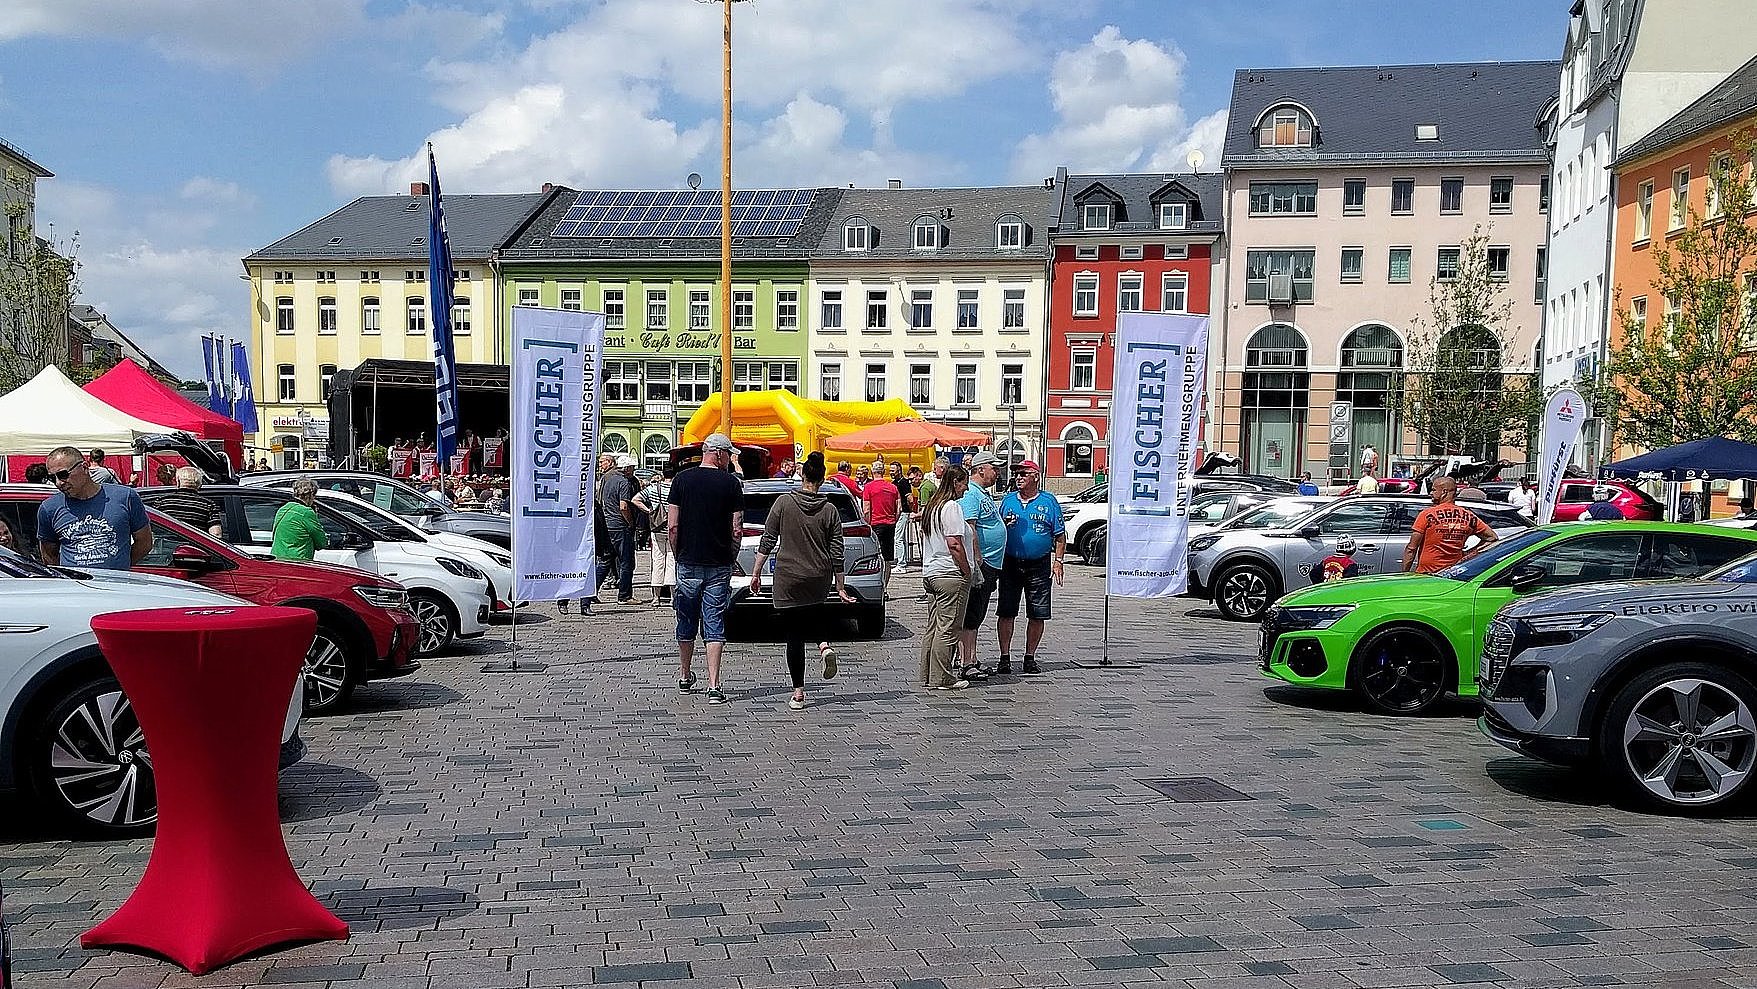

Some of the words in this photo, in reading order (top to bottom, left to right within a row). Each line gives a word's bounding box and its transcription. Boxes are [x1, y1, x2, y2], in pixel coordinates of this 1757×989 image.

[734, 336, 756, 349] Bar
[578, 344, 595, 517] UNTERNEHMENSGRUPPE
[524, 572, 587, 580] www.fischer-auto.de
[1622, 603, 1718, 616] Elektro
